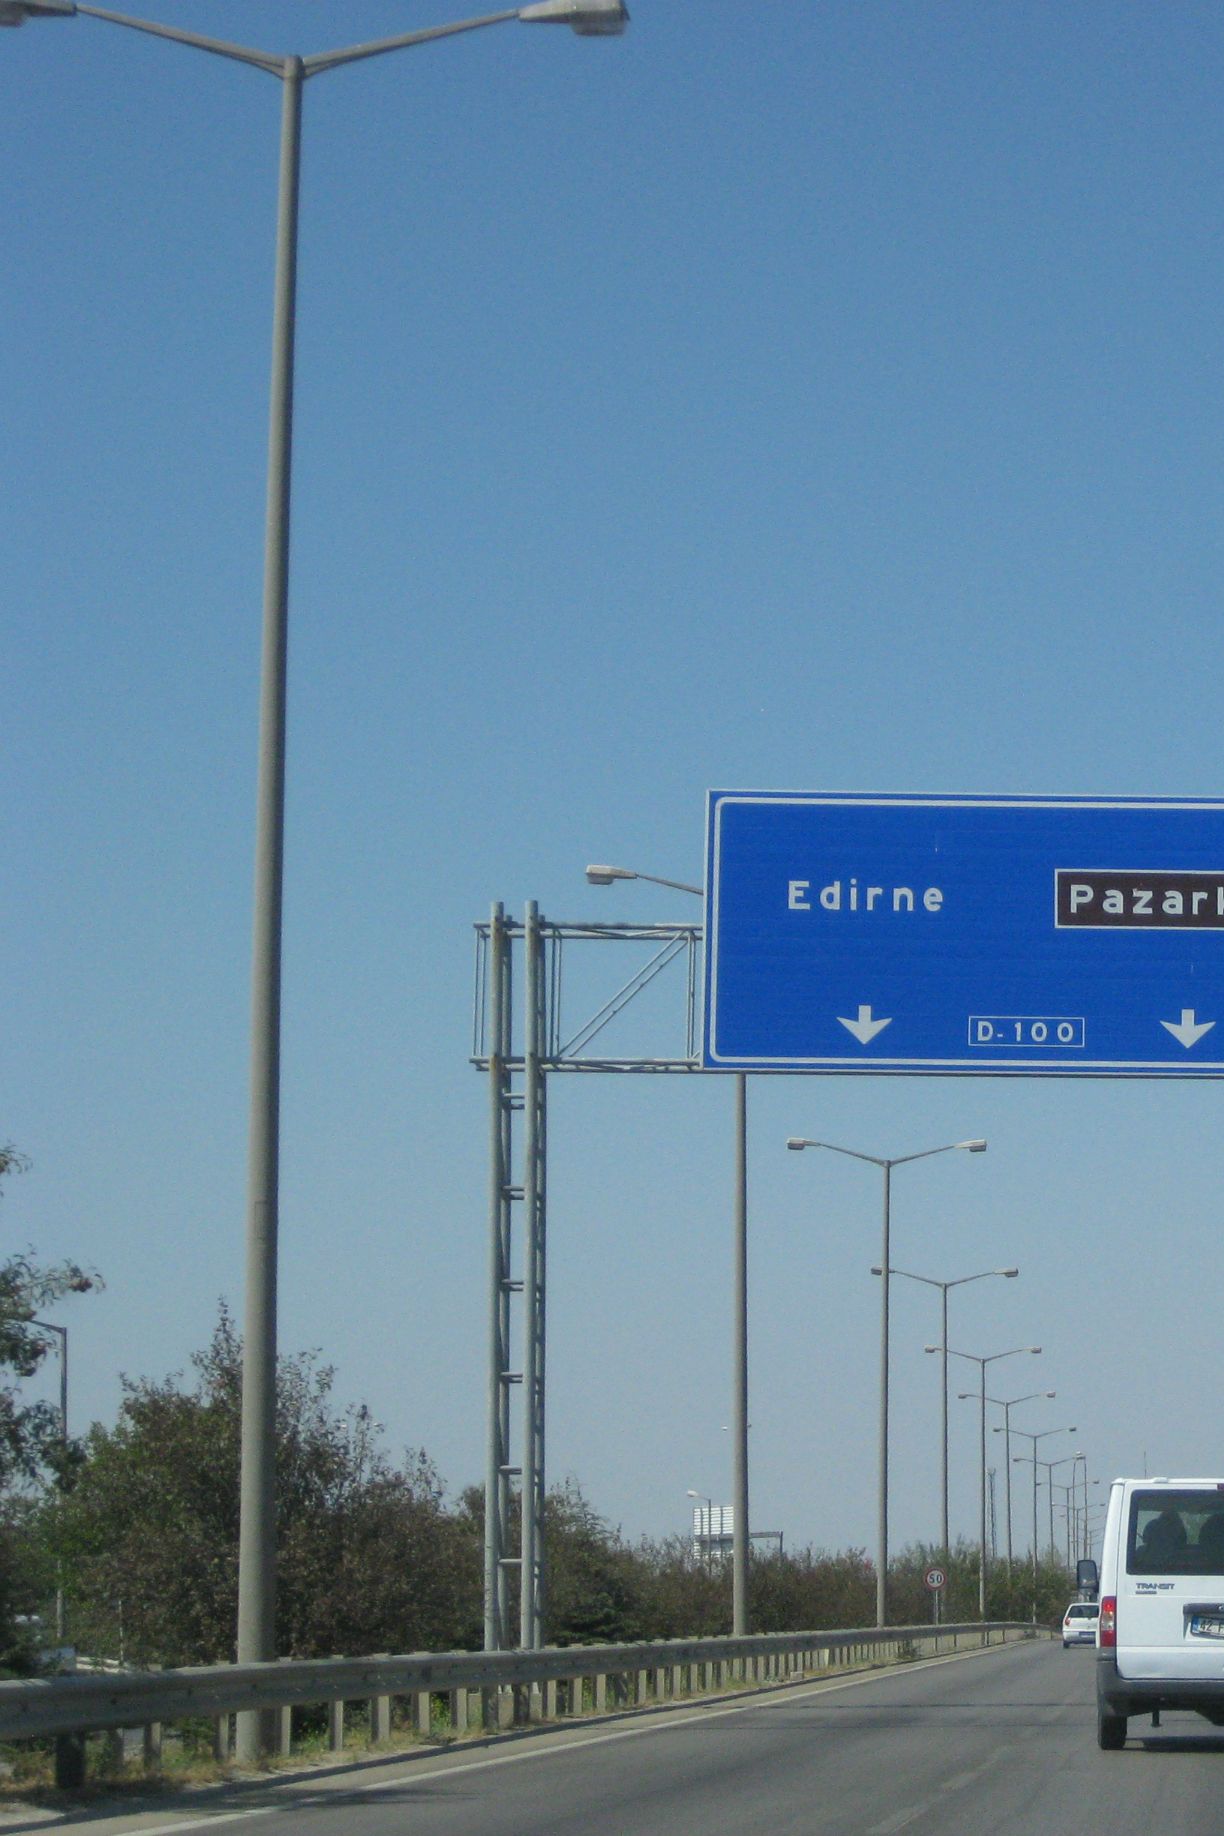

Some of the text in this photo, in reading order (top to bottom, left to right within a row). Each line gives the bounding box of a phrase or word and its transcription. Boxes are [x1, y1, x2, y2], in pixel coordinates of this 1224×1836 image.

[787, 878, 944, 912] Edirne
[977, 1020, 1074, 1042] D-100
[929, 1573, 943, 1584] 50
[1135, 1582, 1175, 1590] TRANSIT
[1200, 1620, 1213, 1632] 42
